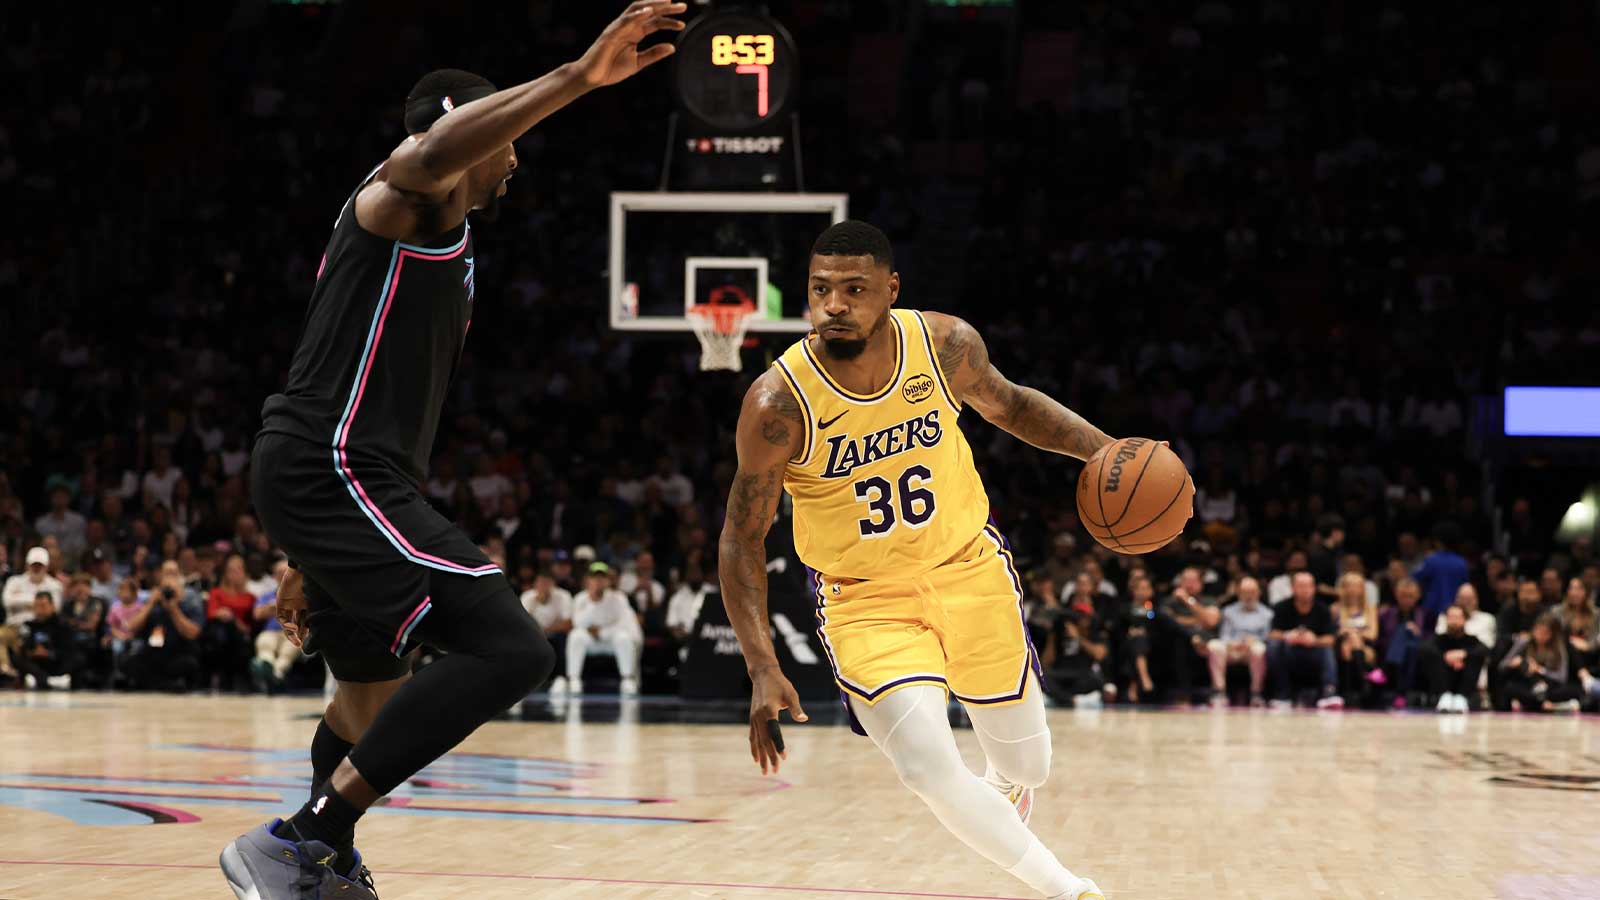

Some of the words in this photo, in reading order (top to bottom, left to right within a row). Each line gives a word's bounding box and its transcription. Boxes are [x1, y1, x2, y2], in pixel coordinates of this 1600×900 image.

[736, 64, 768, 117] 7
[713, 137, 783, 153] TISSOT
[904, 380, 932, 396] bibigo
[819, 409, 943, 479] LAKERS
[853, 464, 936, 540] 36
